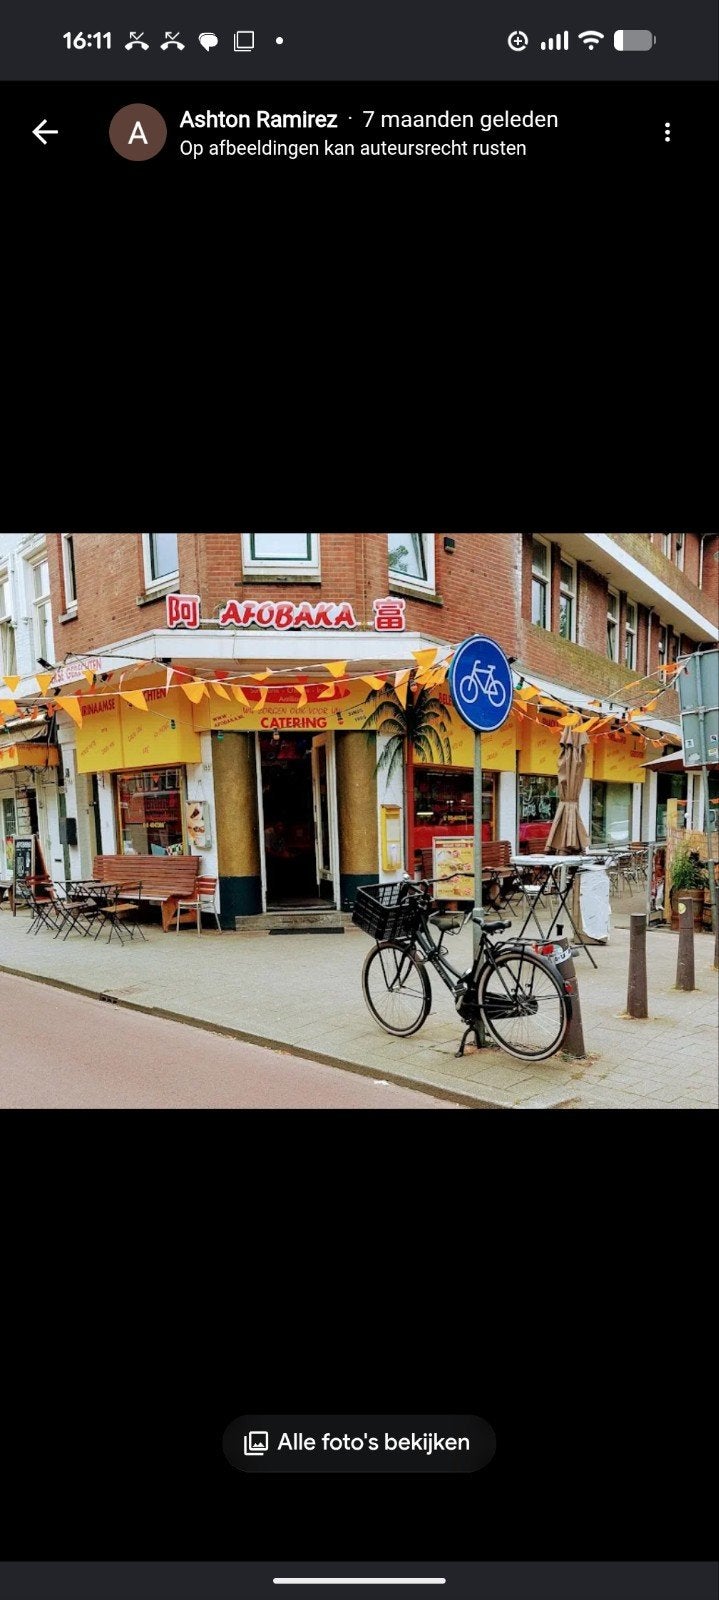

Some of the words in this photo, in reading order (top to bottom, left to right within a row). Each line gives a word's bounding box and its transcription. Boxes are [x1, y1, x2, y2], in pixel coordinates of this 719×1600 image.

[166, 595, 200, 628] 阿
[220, 600, 356, 630] AFOBAKA
[373, 597, 405, 631] 富
[260, 716, 328, 729] CATERING
